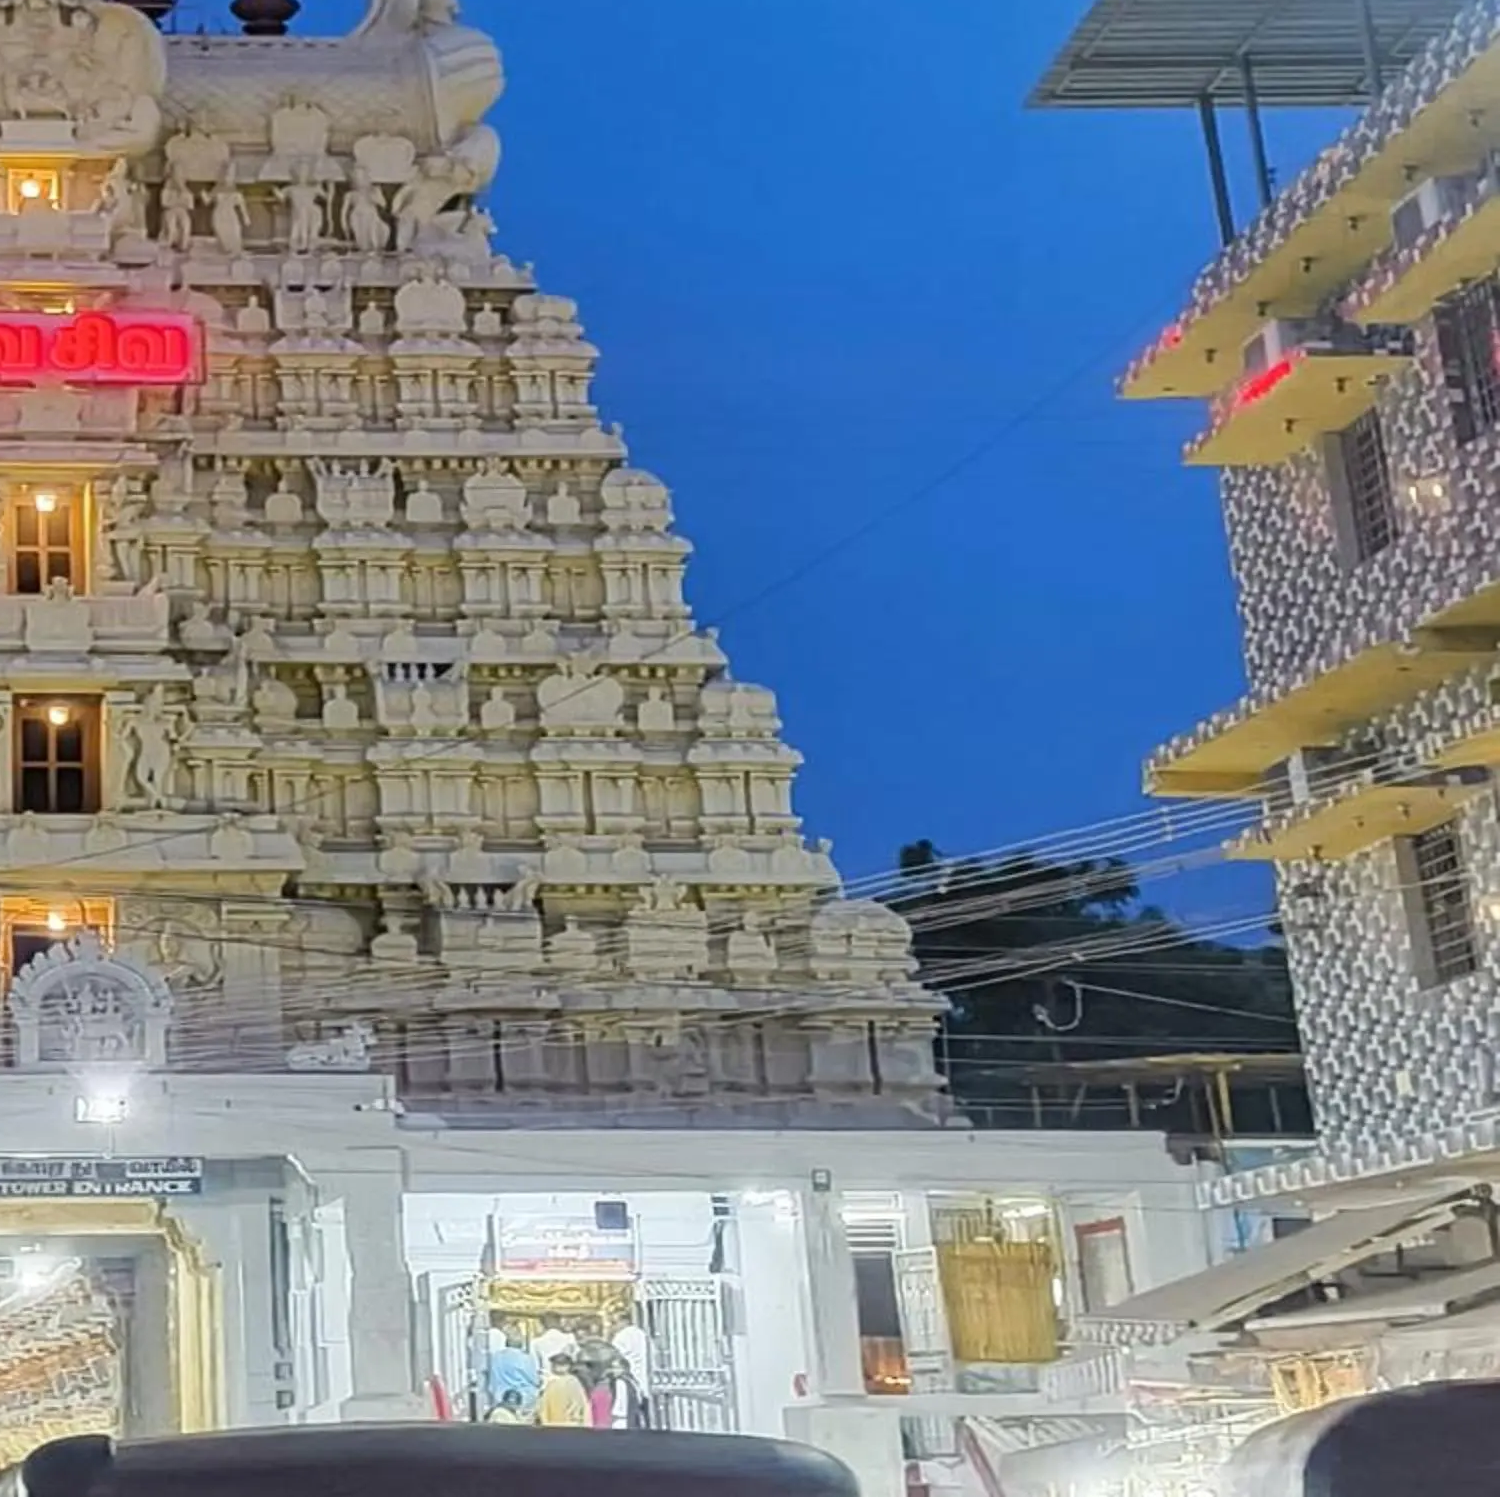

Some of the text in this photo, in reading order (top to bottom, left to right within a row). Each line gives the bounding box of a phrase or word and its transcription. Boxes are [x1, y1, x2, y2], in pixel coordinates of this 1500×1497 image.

[50, 310, 190, 372] சிவ
[0, 1181, 69, 1194] TOWER
[73, 1180, 193, 1194] ENTRANCE
